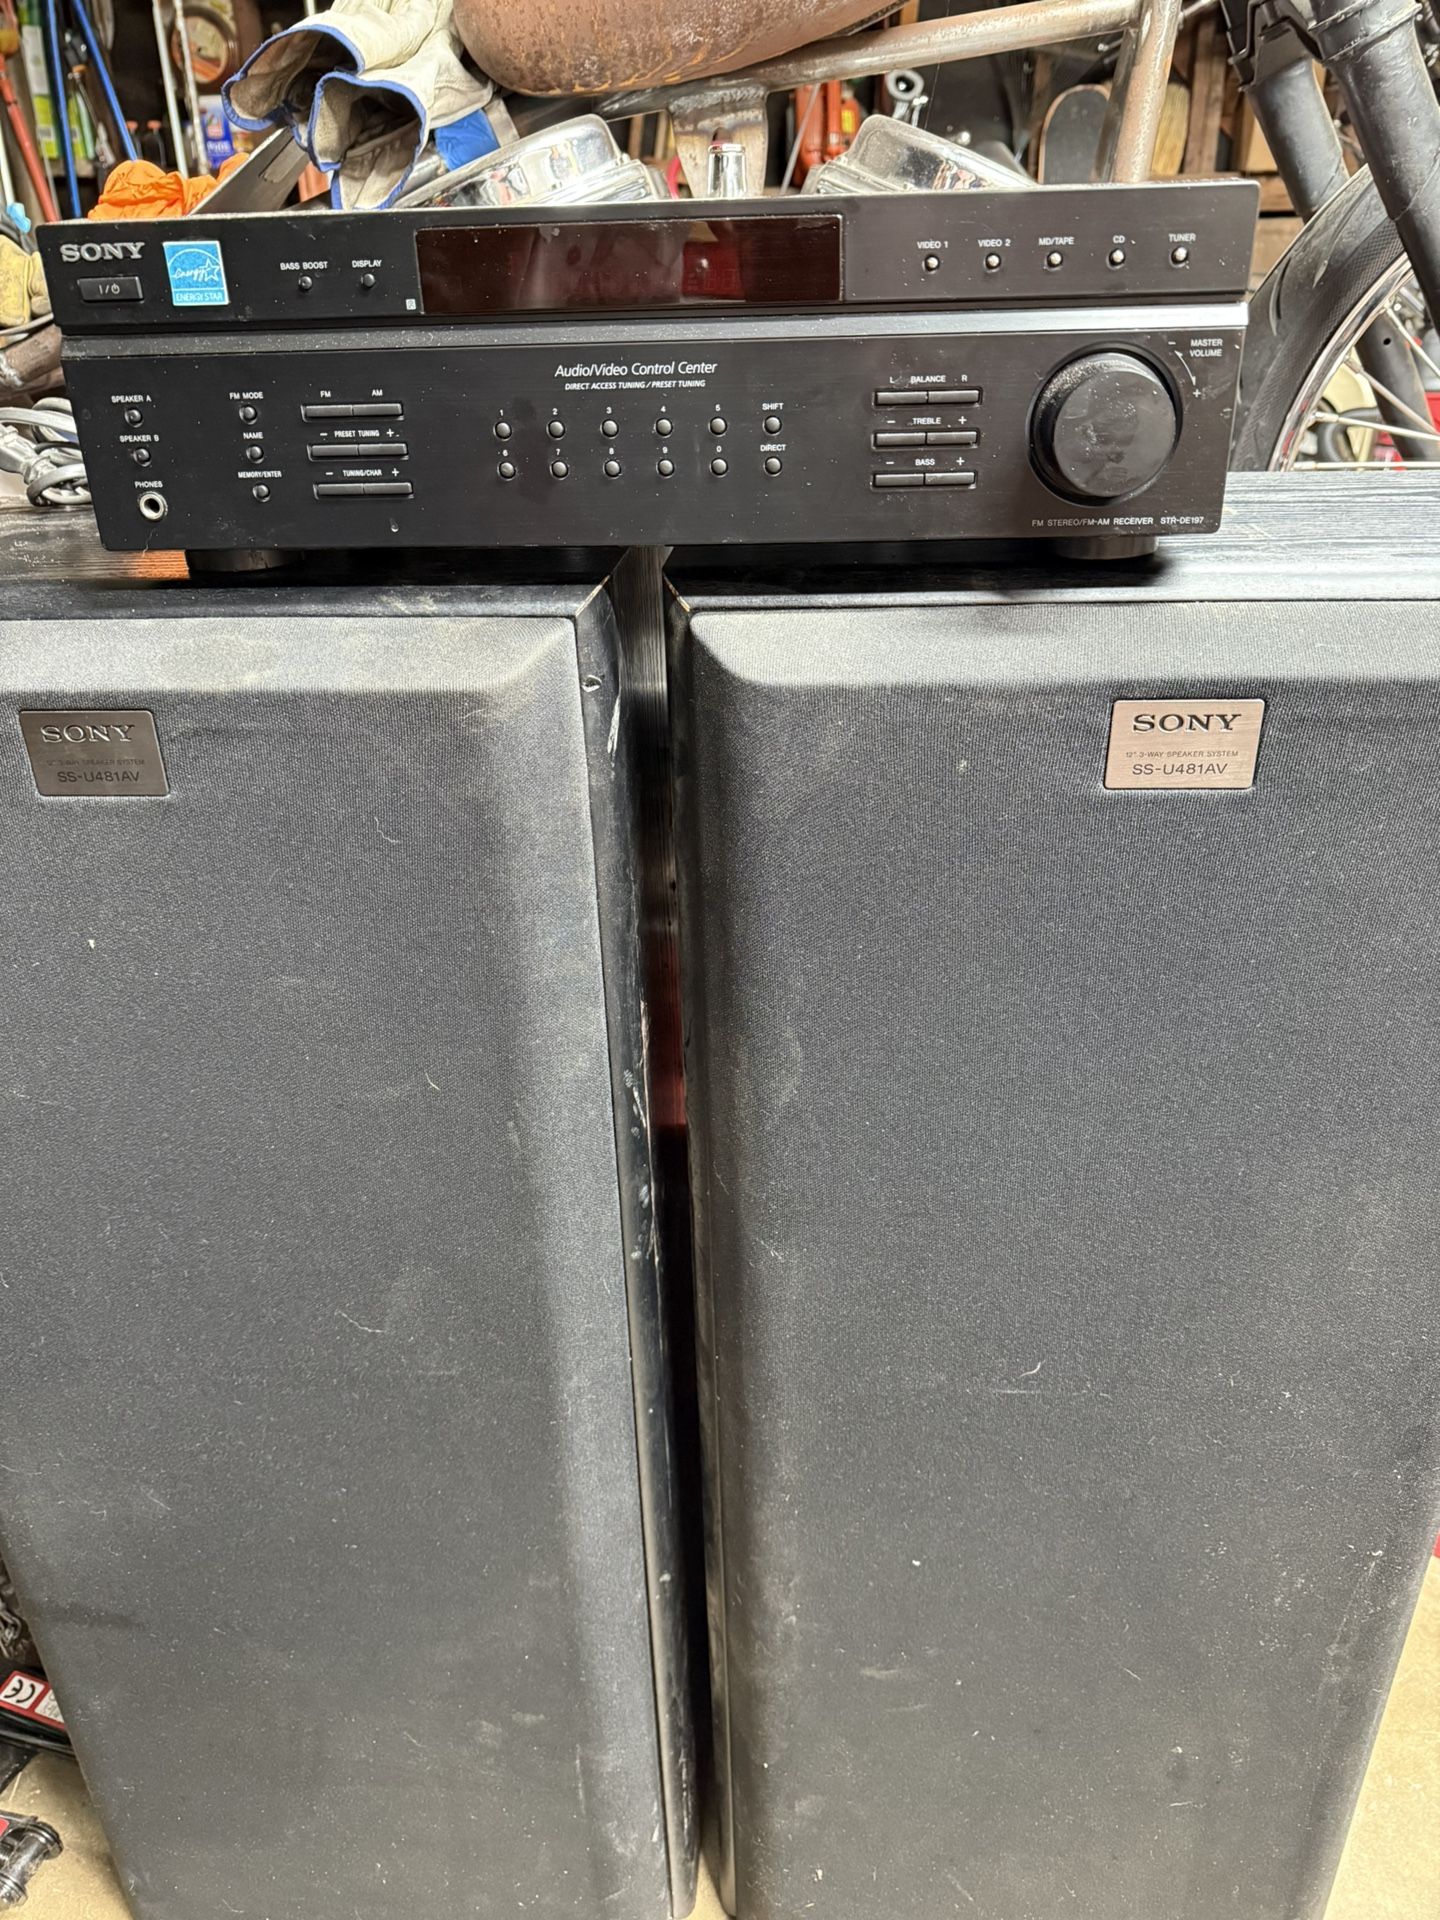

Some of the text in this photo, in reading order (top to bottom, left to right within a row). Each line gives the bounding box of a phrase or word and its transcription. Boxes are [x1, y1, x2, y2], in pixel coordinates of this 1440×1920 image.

[978, 238, 1011, 247] VIDEO 2
[1038, 237, 1075, 246] MD/TAPE
[1112, 236, 1126, 244] CD
[1168, 233, 1196, 243] TUNER
[917, 241, 949, 249] VIDEO 1
[60, 242, 144, 262] SONY
[280, 261, 328, 270] BASS BOOST
[352, 259, 382, 268] DISPLAY
[175, 291, 223, 302] ENERGY STAR
[1190, 338, 1224, 347] MASTER
[1189, 348, 1223, 358] VOLUME
[554, 360, 718, 378] Audio/Video Control Center
[889, 374, 968, 385] L BALANCE R
[565, 383, 590, 391] DIRECT
[590, 382, 617, 390] ACCESS
[618, 381, 646, 389] TUNING
[651, 380, 678, 388] PRESET
[678, 379, 706, 388] TUNING
[229, 391, 264, 400] FM MODE
[320, 390, 331, 398] FM
[371, 389, 383, 397] AM
[111, 394, 152, 403] SPEAKER A
[715, 404, 721, 412] 5
[762, 402, 784, 411] SHIFT
[499, 409, 504, 417] 1
[552, 408, 558, 416] 2
[912, 417, 941, 425] TREBLE
[242, 431, 264, 440] NAME
[334, 429, 380, 438] PRESET TUNING
[119, 434, 160, 443] SPEAKER B
[556, 447, 561, 456] 7
[609, 446, 615, 455] 8
[663, 446, 668, 454] 9
[716, 445, 722, 454] 0
[760, 443, 786, 452] DIRECT
[502, 448, 508, 457] 6
[914, 458, 936, 466] BASS
[237, 470, 282, 479] MEMORY/ENTER
[342, 468, 383, 477] TUNING/CHAR
[134, 480, 163, 489] PHONES
[1031, 515, 1204, 527] FM STEREO/FM-AM RECEIVER STR-DE197
[1132, 713, 1242, 733] SONY
[40, 724, 136, 743] SONY
[1167, 749, 1204, 758] SPEAKER
[1207, 749, 1239, 757] SYSTEM
[1132, 762, 1228, 776] SS-U481AV
[57, 770, 140, 783] SS-U481AV
